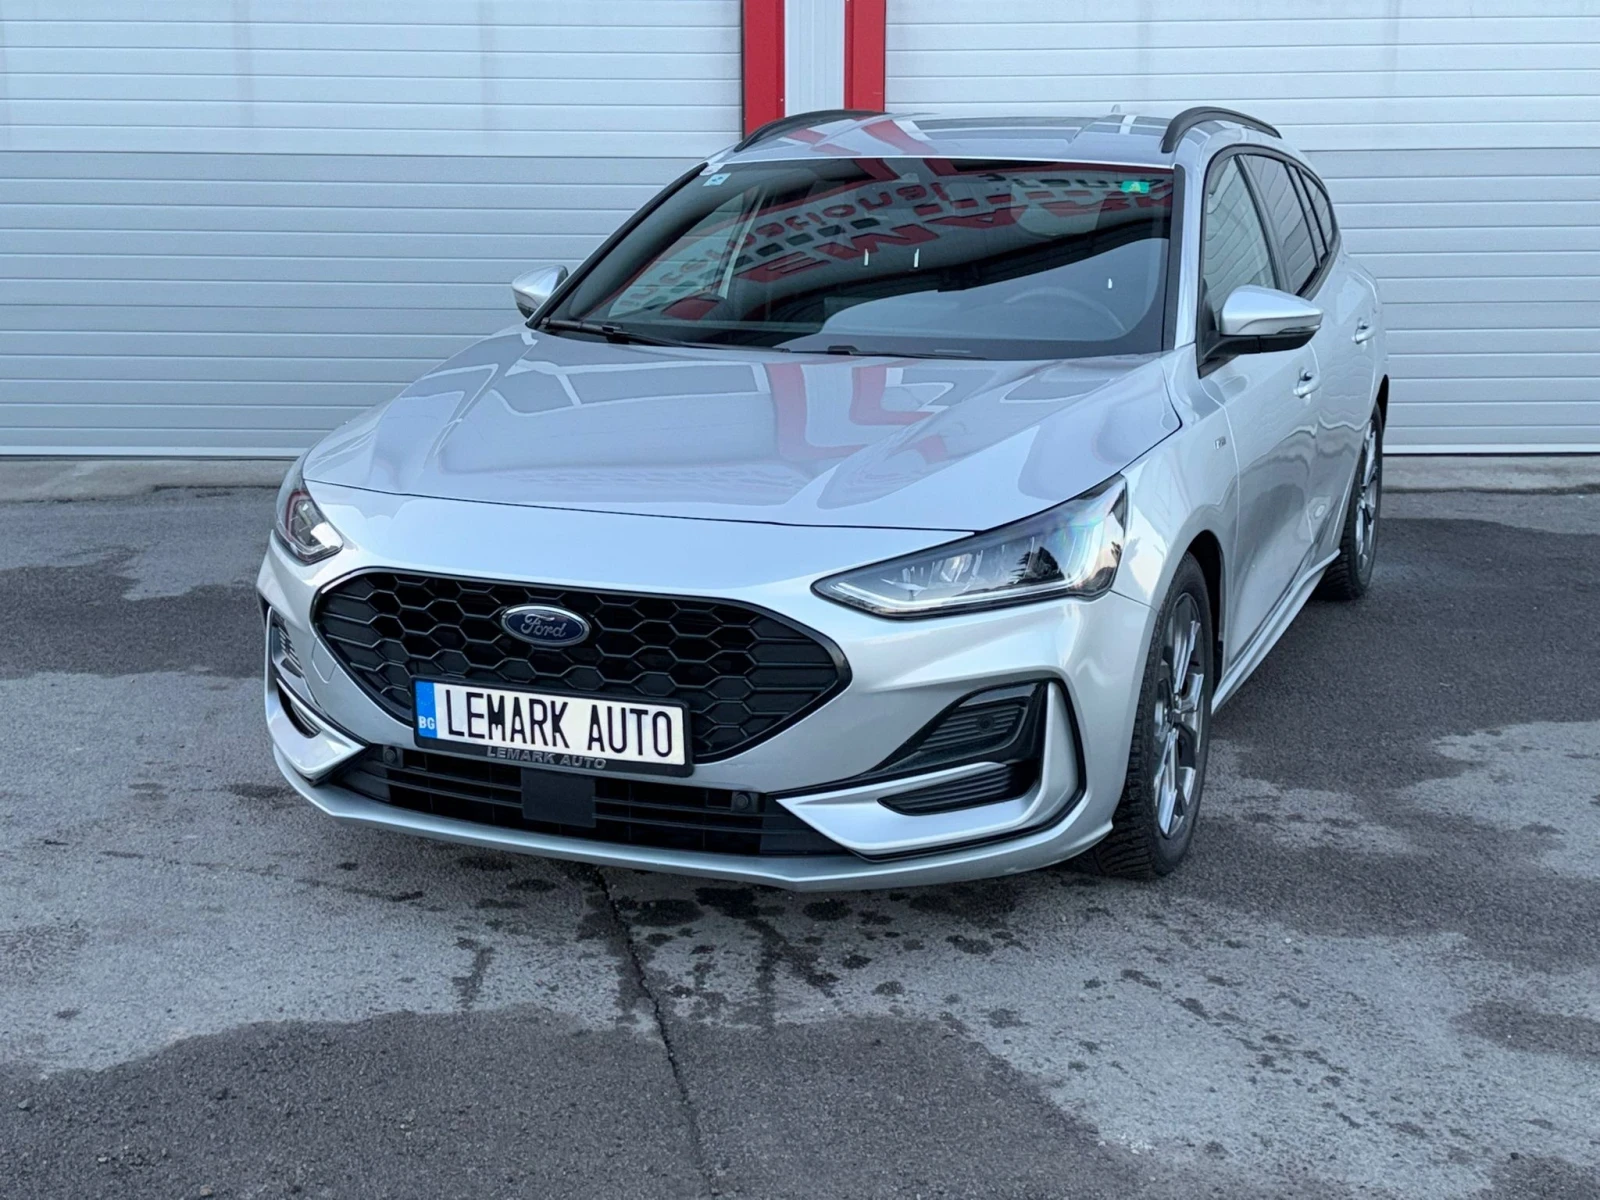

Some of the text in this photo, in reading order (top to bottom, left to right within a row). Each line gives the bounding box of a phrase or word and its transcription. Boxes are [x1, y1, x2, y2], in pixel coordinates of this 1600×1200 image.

[520, 613, 567, 637] Ford
[418, 689, 672, 758] BG LEMARK AUTO
[486, 747, 607, 769] LEMARK AUTO
